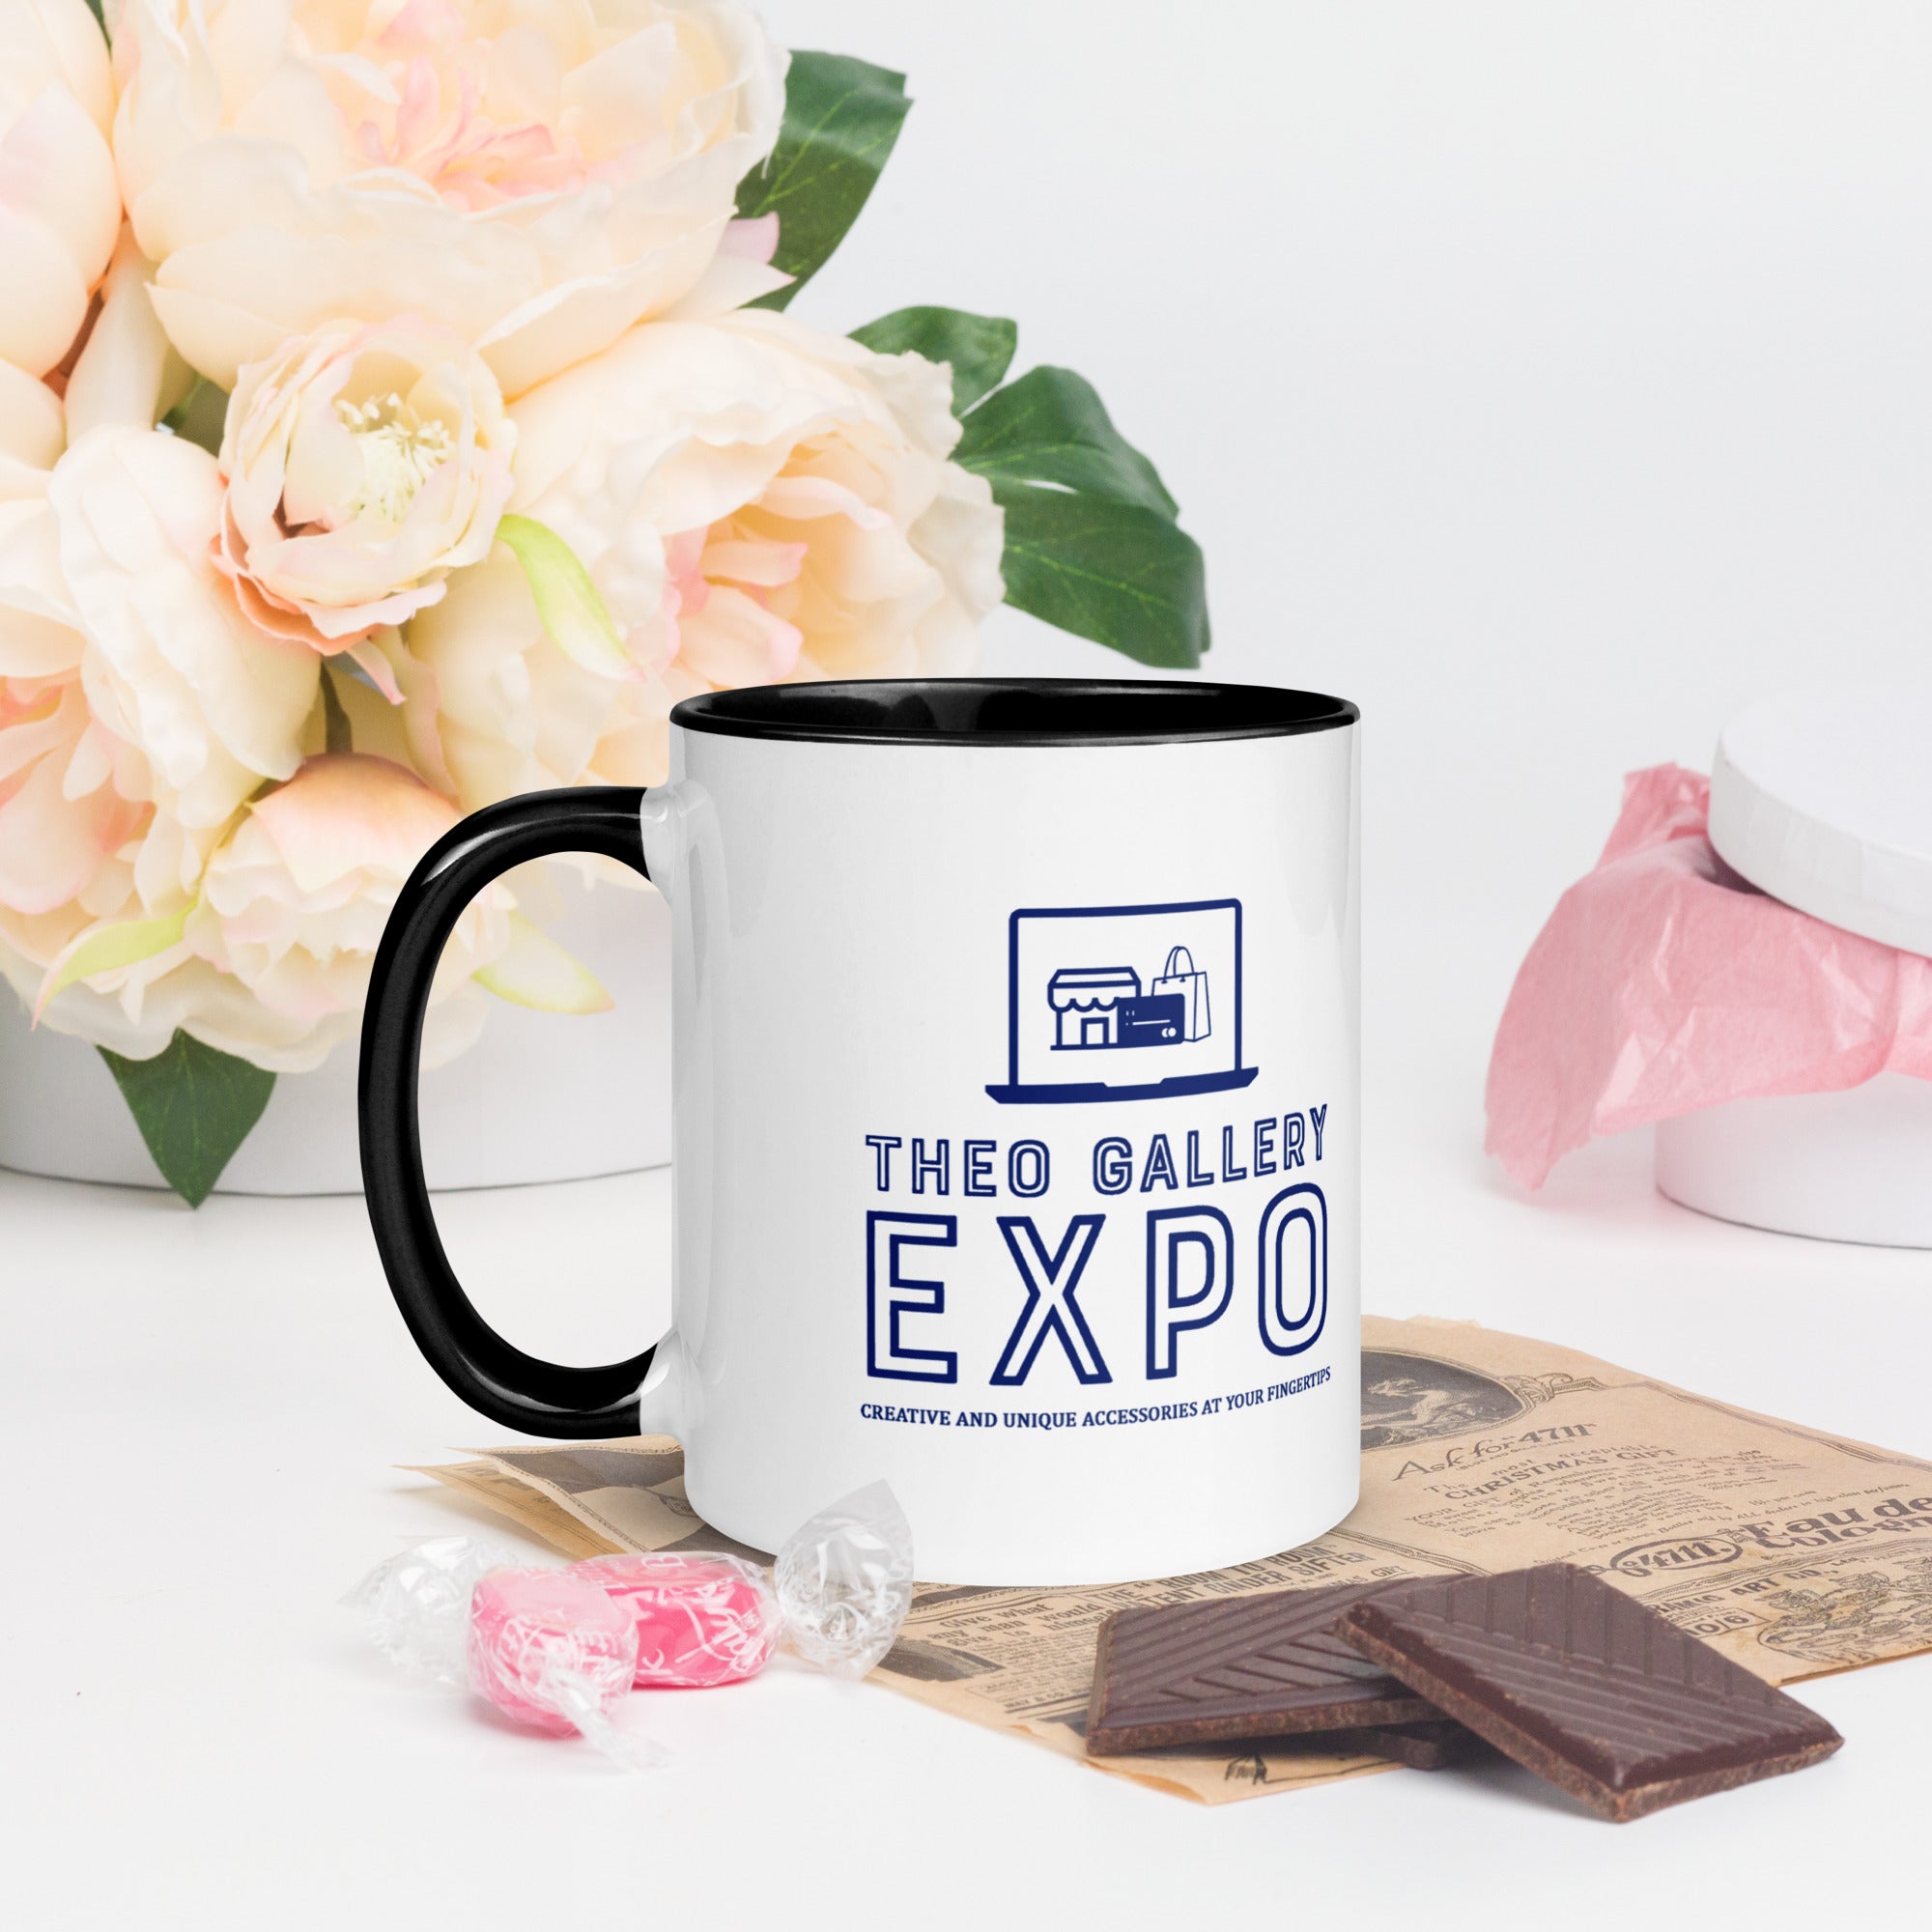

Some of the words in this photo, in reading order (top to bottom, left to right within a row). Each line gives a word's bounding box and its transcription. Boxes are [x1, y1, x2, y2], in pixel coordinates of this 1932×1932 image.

[866, 1134, 1050, 1198] THEO
[1093, 1103, 1327, 1196] GALLERY
[866, 1182, 1327, 1386] EXPO
[861, 1404, 951, 1426] CREATIVE
[955, 1411, 998, 1428] AND
[1004, 1412, 1076, 1431] UNIQUE
[1082, 1402, 1198, 1427] ACCESSORIES
[1202, 1398, 1222, 1415] AT
[1227, 1389, 1264, 1410] YOUR
[1267, 1367, 1330, 1402] FINGERTIPS
[1391, 1447, 1463, 1482] Ask
[1472, 1439, 1516, 1458] for
[1445, 1456, 1608, 1499] CHRISTMAS
[1616, 1448, 1678, 1461] GIFT
[1741, 1507, 1869, 1540] Eau
[1873, 1497, 1932, 1518] de
[1203, 1570, 1293, 1595] CINDER
[1287, 1551, 1376, 1577] SIFTER
[1370, 1565, 1407, 1577] GIFT
[1729, 1577, 1781, 1597] ART
[940, 1613, 991, 1629] Give
[995, 1603, 1054, 1619] what
[1086, 1588, 1144, 1603] THE
[980, 1619, 1030, 1633] man
[1037, 1603, 1106, 1623] would
